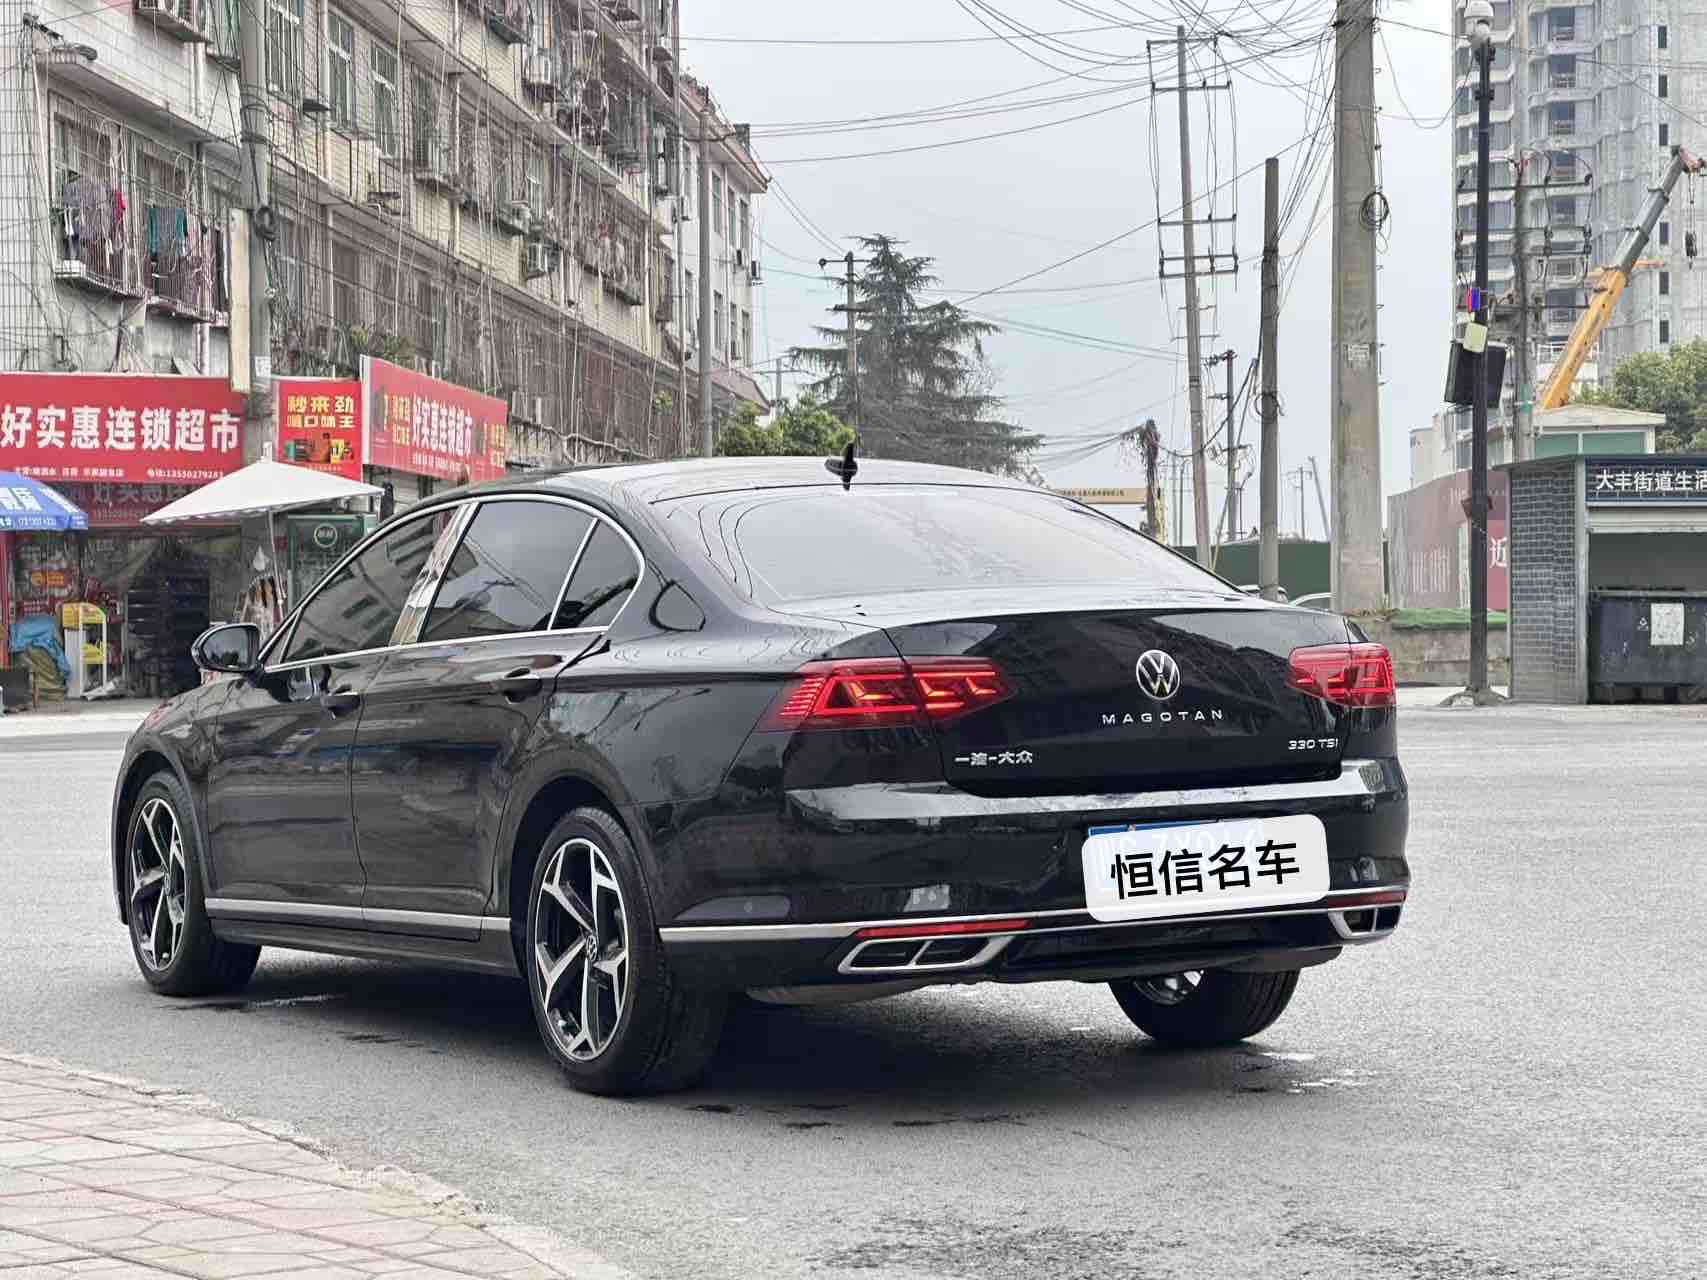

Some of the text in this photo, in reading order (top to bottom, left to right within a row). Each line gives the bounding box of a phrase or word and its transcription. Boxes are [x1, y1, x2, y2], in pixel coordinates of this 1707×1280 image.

[0, 404, 241, 453] 好实惠连锁超市
[1595, 469, 1707, 493] 大丰街道生活
[1102, 708, 1224, 725] MAGOTAN
[1287, 737, 1339, 751] 330 TSI
